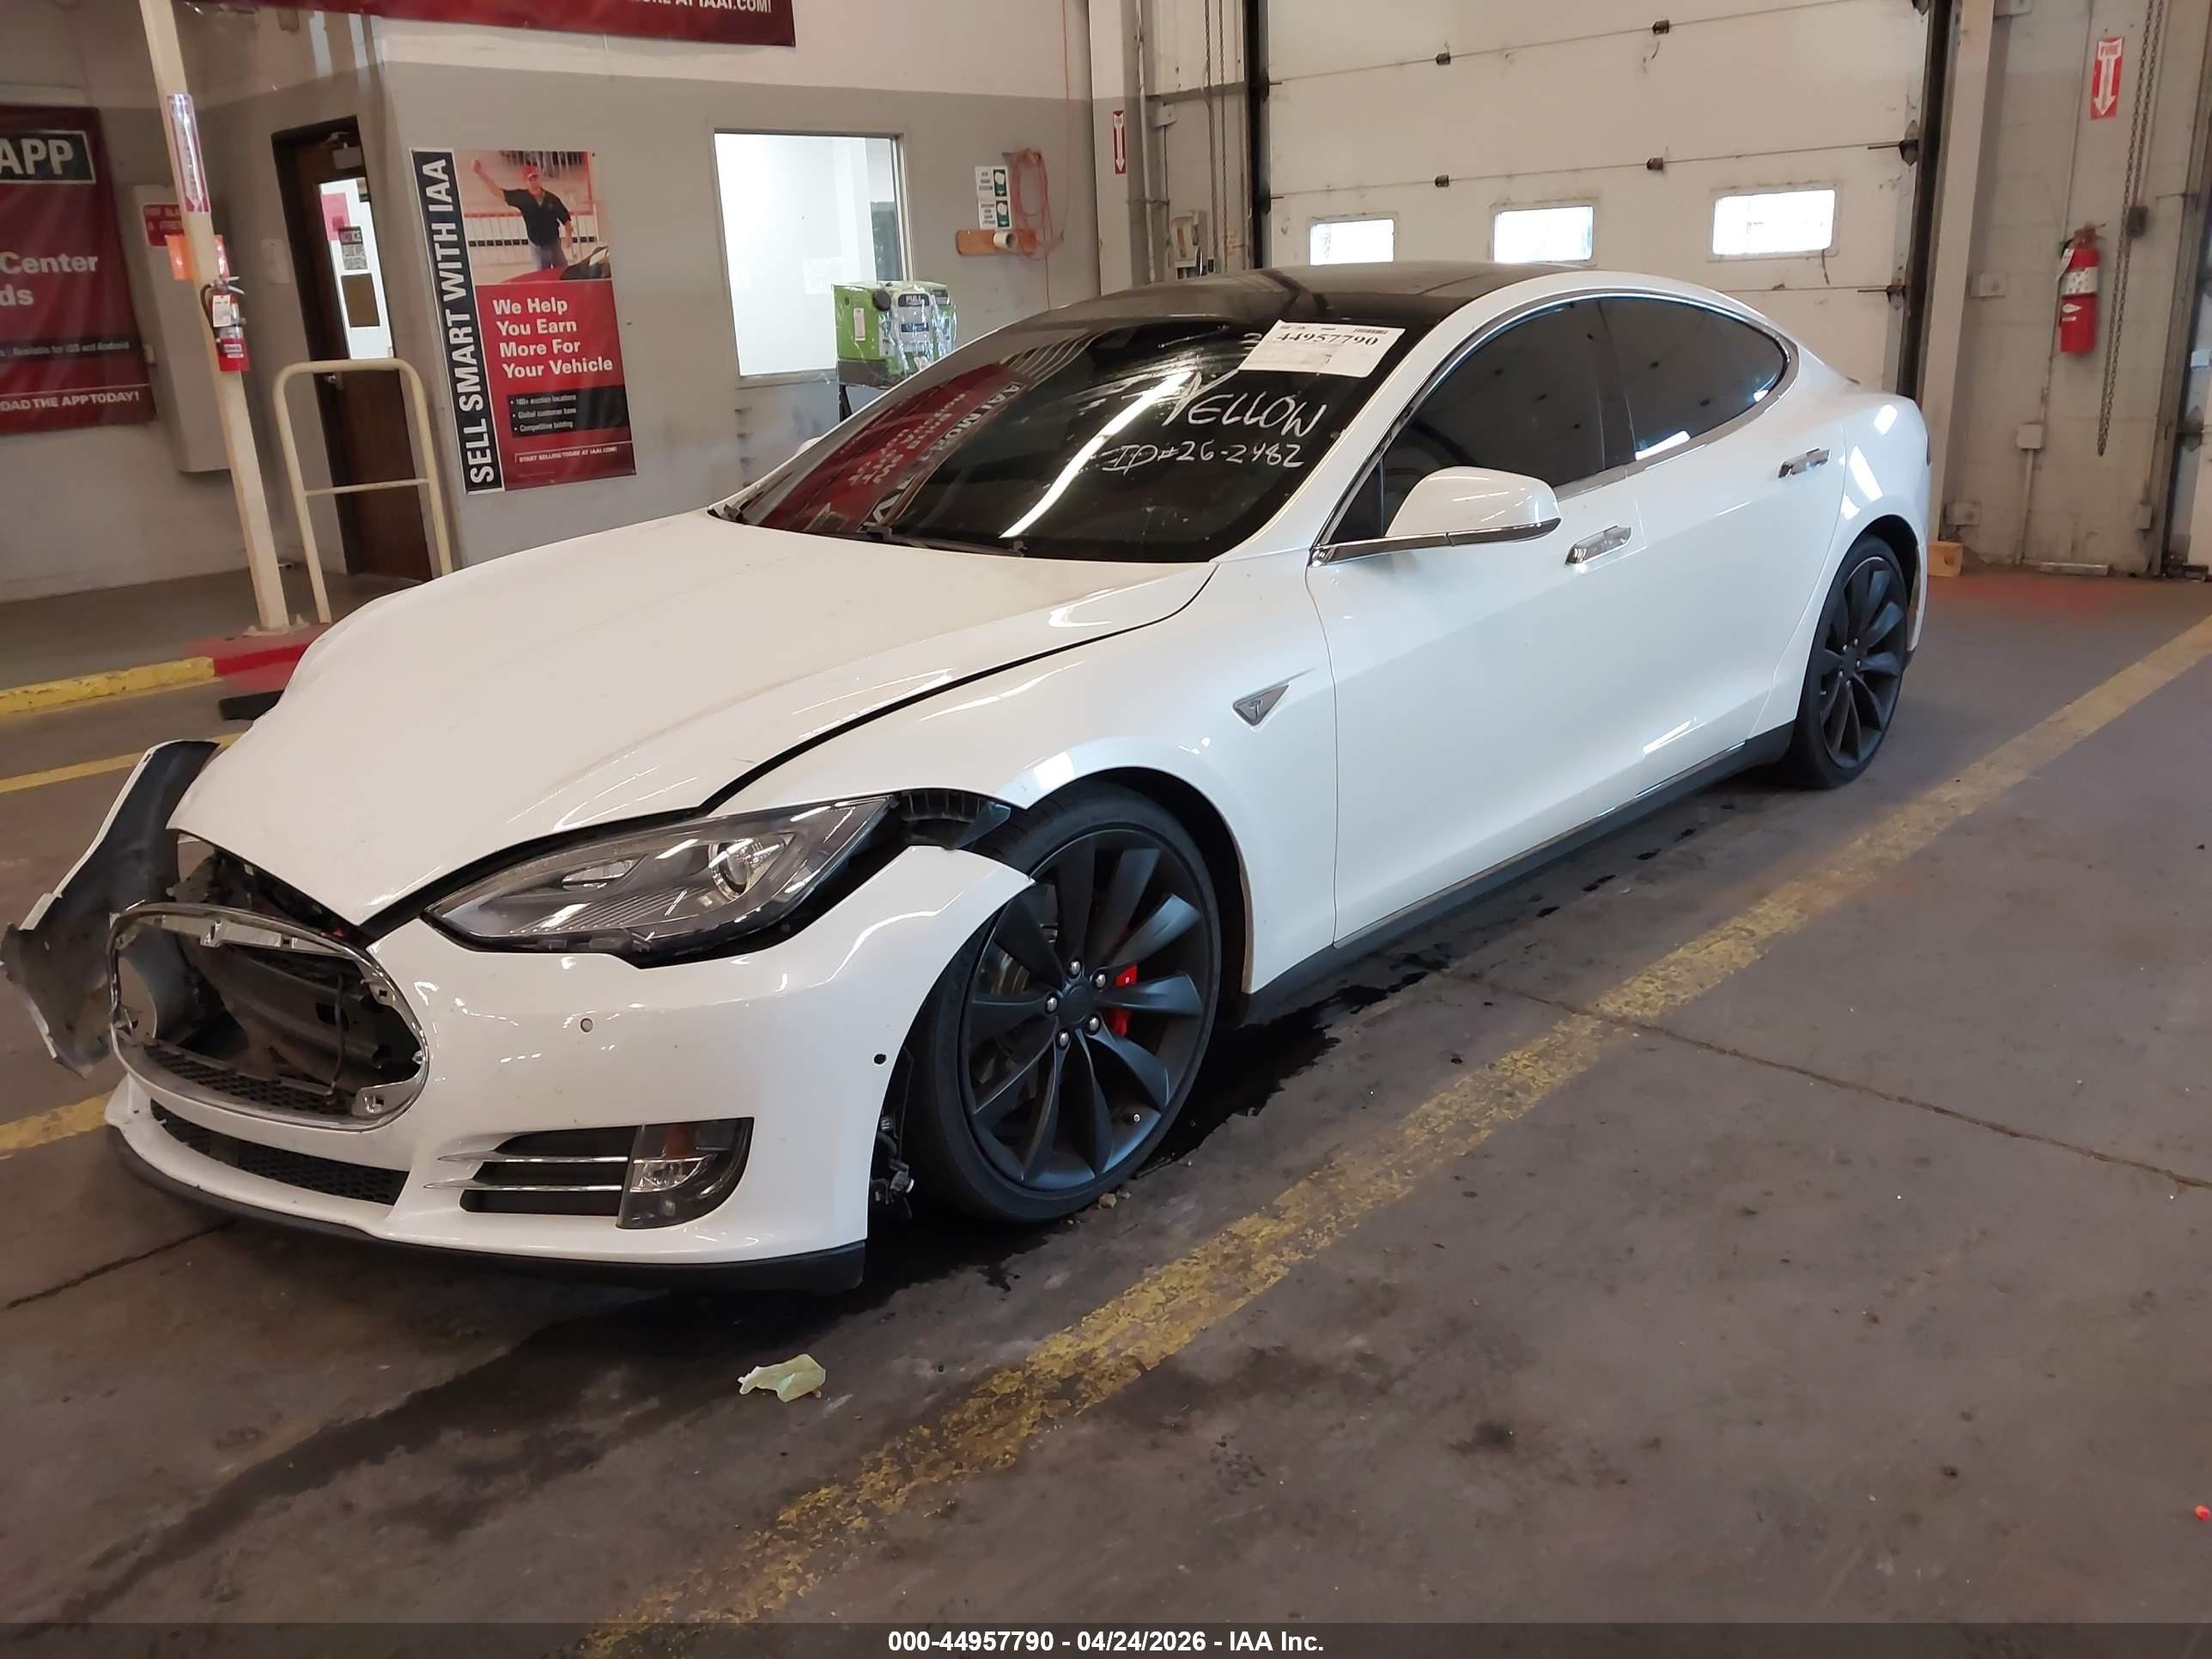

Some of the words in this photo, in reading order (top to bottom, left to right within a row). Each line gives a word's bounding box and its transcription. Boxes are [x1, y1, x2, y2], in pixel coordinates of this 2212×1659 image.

[0, 138, 74, 175] APP
[422, 159, 454, 212] IAA
[0, 252, 98, 274] Center
[432, 222, 465, 302] WITH
[493, 299, 521, 315] We
[527, 296, 568, 315] Help
[496, 320, 531, 336] You
[537, 319, 577, 334] Earn
[1278, 332, 1379, 345] 44957790
[499, 342, 547, 358] More
[552, 339, 580, 354] For
[445, 309, 484, 412] SMART
[502, 363, 544, 379] Your
[550, 356, 613, 374] Vehicle
[33, 397, 59, 408] THE
[62, 395, 88, 406] APP
[88, 392, 139, 403] TODAY!
[1162, 369, 1328, 437] YELLOW
[464, 417, 495, 484] SELL
